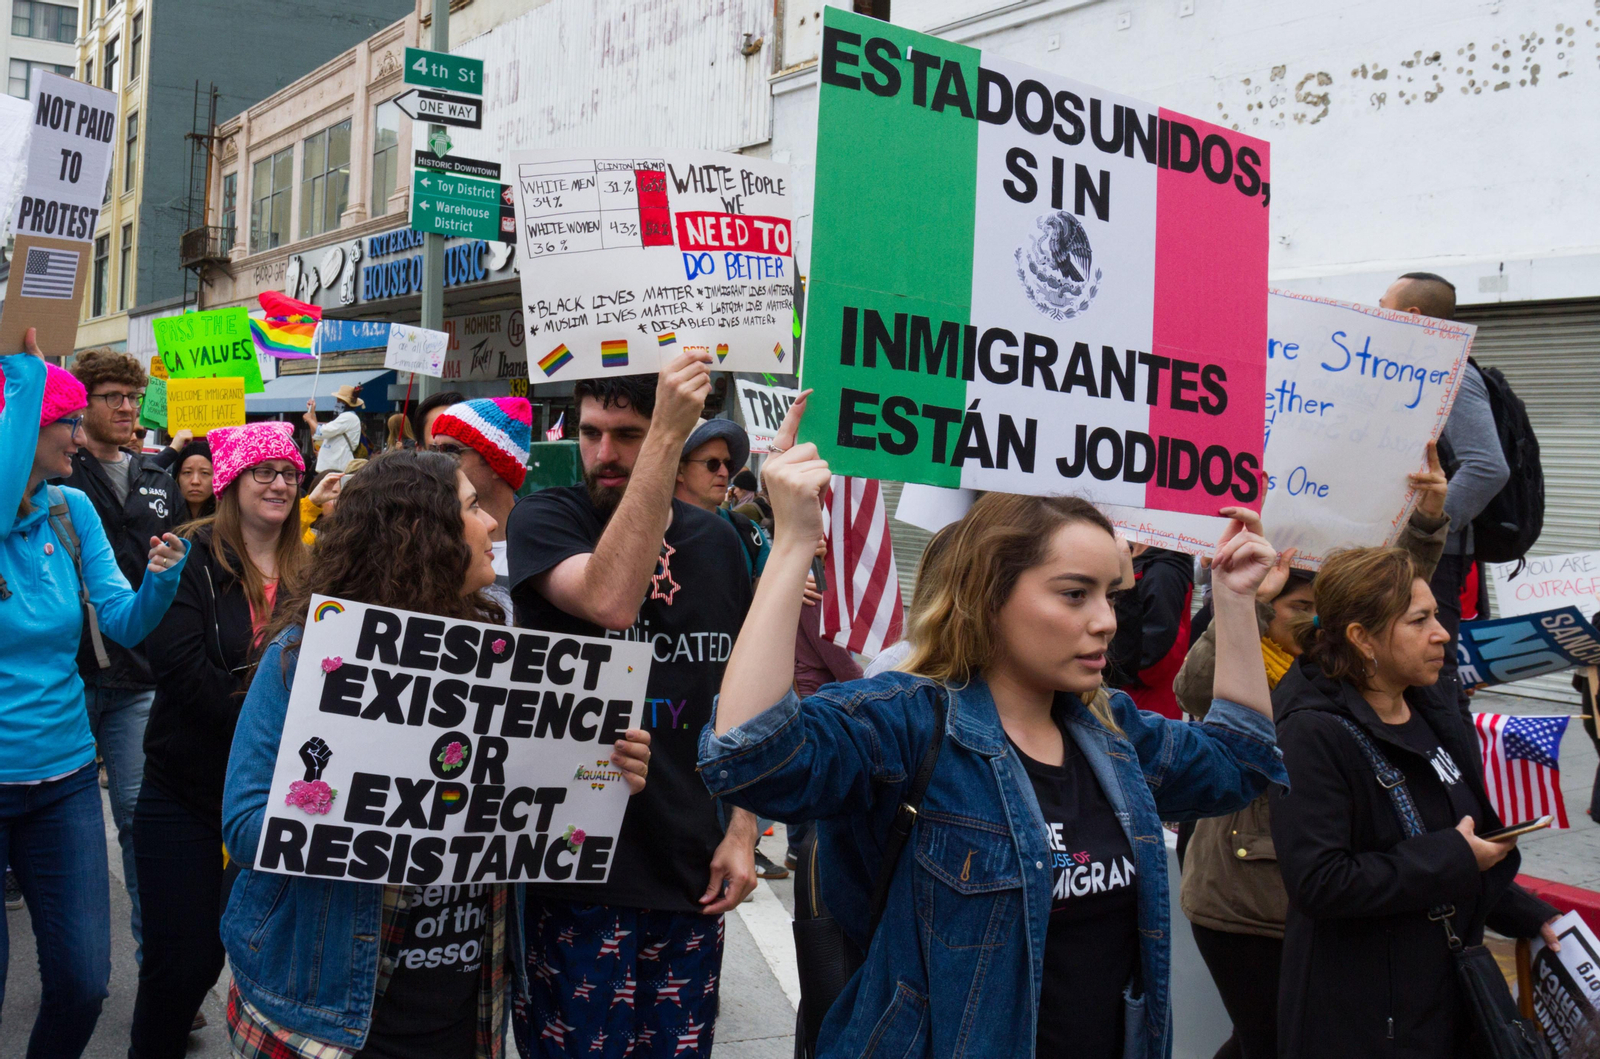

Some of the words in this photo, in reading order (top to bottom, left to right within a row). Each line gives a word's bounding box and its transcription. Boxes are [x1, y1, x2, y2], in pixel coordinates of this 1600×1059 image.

[412, 57, 448, 79] 4th
[458, 67, 476, 84] St
[35, 92, 75, 133] NOT
[76, 103, 115, 144] PAID
[419, 99, 444, 115] ONE
[449, 103, 473, 119] WAY
[59, 148, 82, 184] TO
[596, 162, 633, 171] CLINTON
[637, 161, 665, 172] TRUMP
[667, 163, 737, 195] WHITE
[740, 168, 786, 197] PEOPLE
[437, 180, 454, 195] Toy
[457, 182, 496, 199] District
[520, 179, 570, 195] WHITE
[571, 176, 595, 191] MEN
[1003, 147, 1110, 222] SIN
[17, 196, 99, 240] PROTEST
[436, 201, 490, 219] Warehouse
[720, 194, 745, 216] WE
[434, 217, 473, 232] District
[527, 222, 567, 239] WHITE
[567, 220, 600, 233] WOMEN
[685, 216, 748, 246] NEED
[753, 219, 790, 253] TO
[367, 227, 424, 258] INTERNA
[362, 257, 408, 301] HOUSE
[683, 252, 715, 280] DO
[724, 252, 784, 281] BETTER
[537, 296, 583, 318] BLACK
[592, 289, 635, 308] LIVES
[643, 285, 693, 301] MATTER
[704, 284, 747, 299] IMMIGRANT
[749, 285, 766, 298] LIVES
[544, 314, 588, 333] MUSLIM
[596, 308, 637, 325] LIVES
[641, 302, 693, 318] MATTER
[746, 300, 763, 312] LIVES
[1283, 289, 1337, 307] Communities
[1352, 302, 1370, 315] Our
[1423, 316, 1438, 329] Our
[157, 317, 194, 346] PASS
[201, 315, 237, 337] THE
[464, 314, 501, 336] HOHNER
[652, 316, 715, 333] DISABLED
[718, 316, 740, 328] LIVES
[743, 314, 772, 325] MATTER
[164, 350, 185, 373] CA
[189, 339, 252, 369] VALUES
[496, 350, 528, 378] Ibane
[840, 306, 1227, 416] INMIGRANTES
[1321, 331, 1450, 409] Stronger
[168, 388, 202, 402] WELCOME
[204, 387, 244, 401] IMMIGRANTS
[508, 378, 528, 397] 339
[1265, 378, 1334, 417] ether
[176, 406, 209, 422] DEPORT
[211, 404, 237, 420] HATE
[836, 388, 1037, 474] ESTÁN
[1056, 424, 1258, 504] JODIDOS
[1287, 466, 1329, 497] One
[1136, 531, 1168, 548] Latino
[1139, 523, 1175, 540] African
[1524, 558, 1553, 577] YOU
[1559, 554, 1597, 573] ARE
[356, 608, 612, 691] RESPECT
[319, 661, 633, 745] EXISTENCE
[430, 731, 509, 784] OR
[577, 769, 622, 782] EQUALITY
[344, 772, 567, 833] EXPECT
[260, 816, 614, 886] RESISTANCE
[1073, 851, 1091, 864] OF
[415, 908, 450, 938] of
